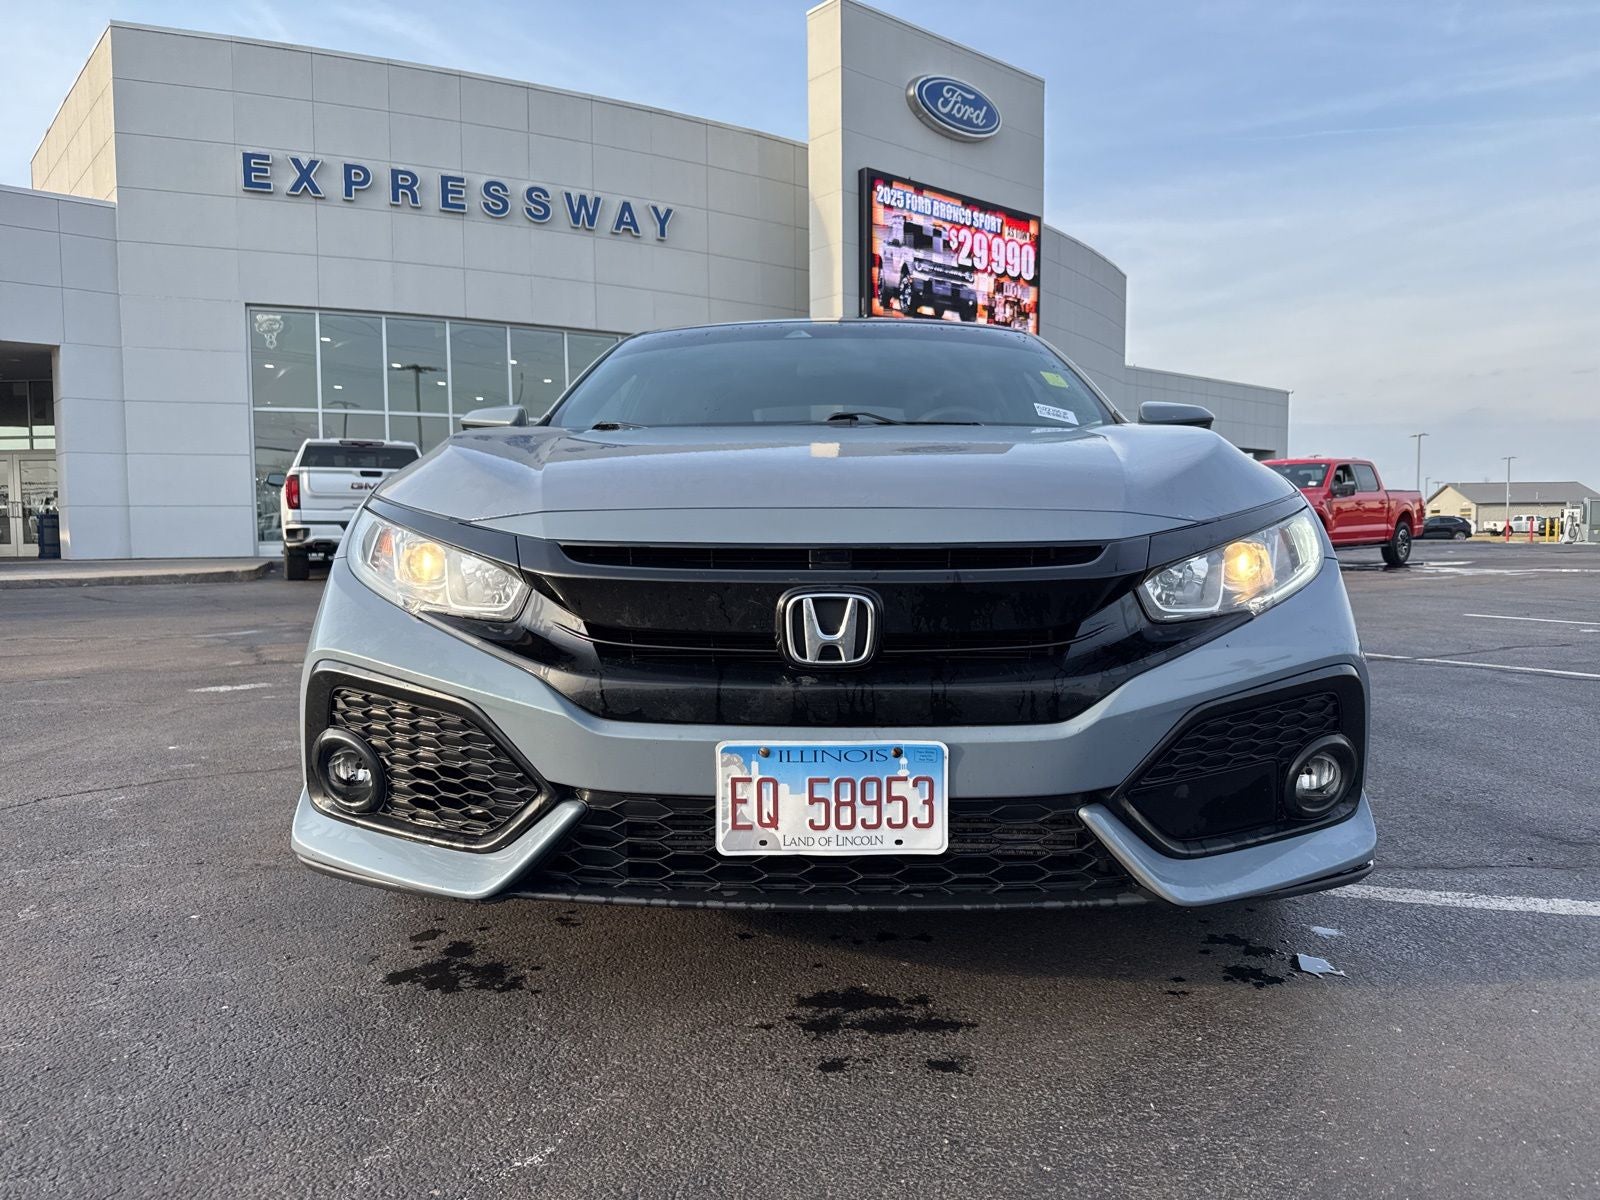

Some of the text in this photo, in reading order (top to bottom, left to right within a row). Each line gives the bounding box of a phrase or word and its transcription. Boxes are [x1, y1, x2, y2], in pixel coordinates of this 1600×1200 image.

[938, 85, 987, 126] Ford
[239, 151, 676, 240] EXPRESSWAY
[876, 184, 1003, 234] 2025 FORD BRONCO SPORT
[949, 225, 1036, 281] $29,990
[351, 482, 378, 490] GM
[779, 749, 888, 763] ILLINOIS
[730, 776, 935, 831] EQ 58953
